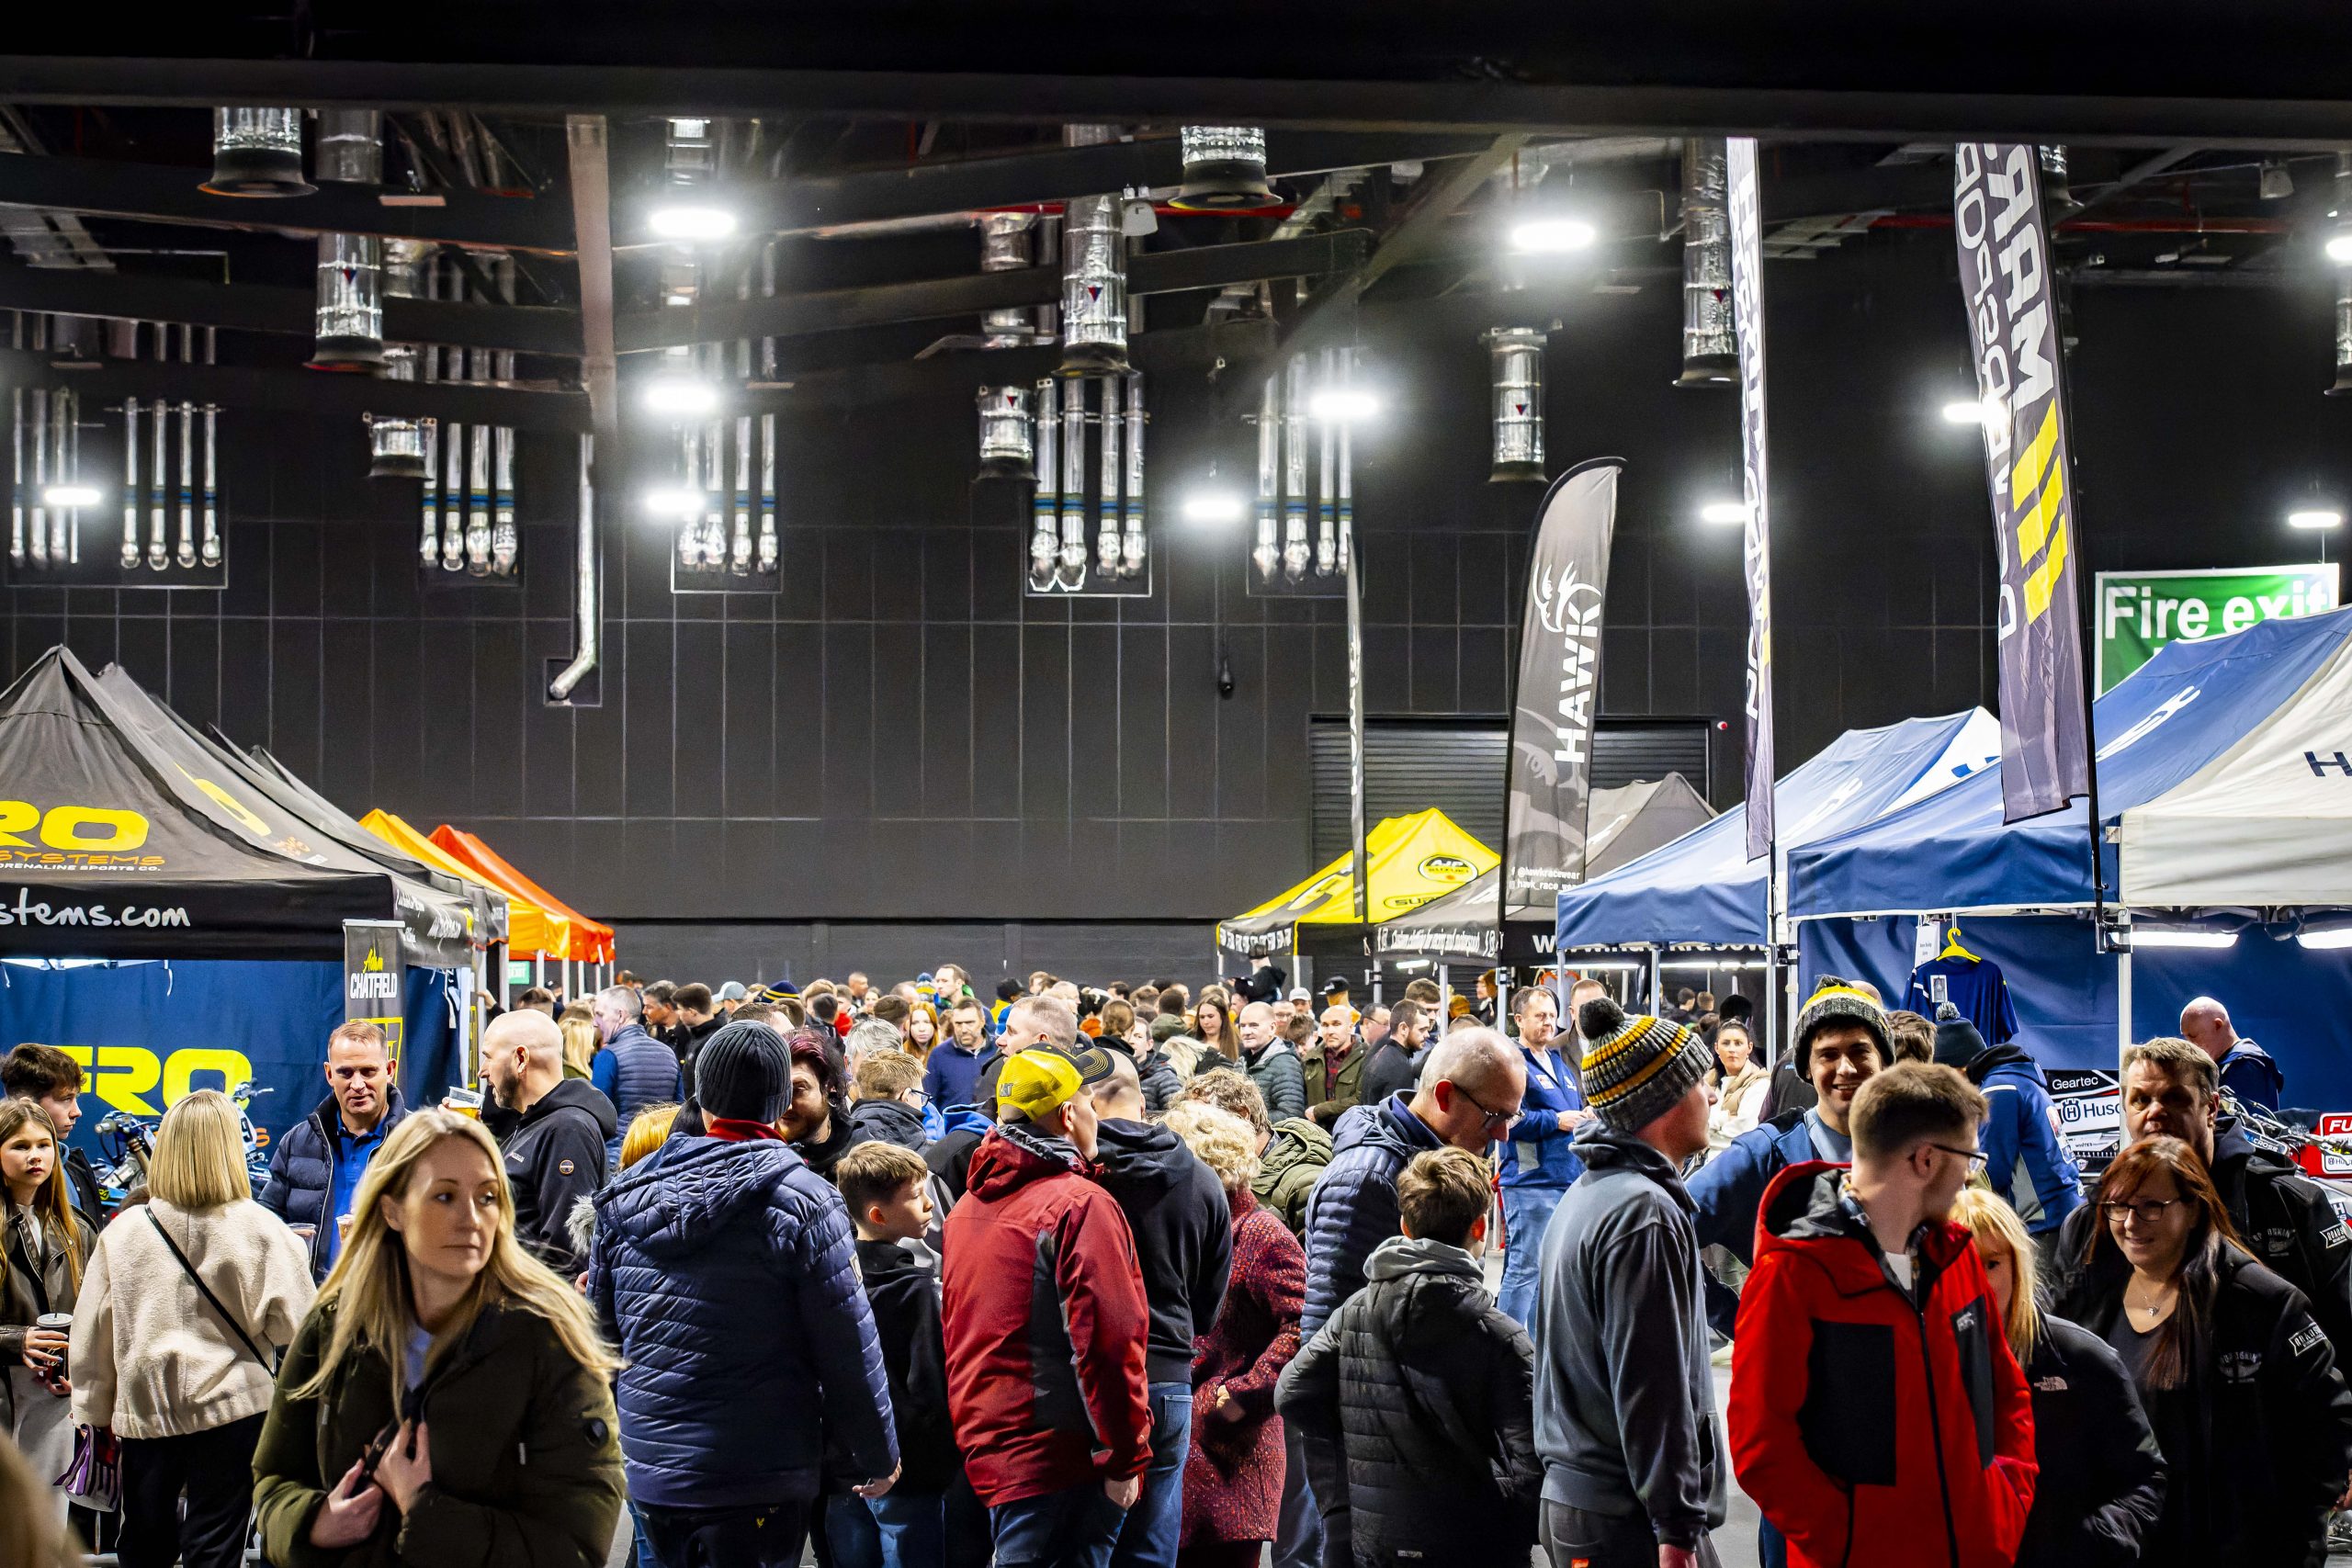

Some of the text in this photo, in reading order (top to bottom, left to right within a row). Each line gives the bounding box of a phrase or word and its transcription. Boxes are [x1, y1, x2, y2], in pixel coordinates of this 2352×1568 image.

[2105, 586, 2210, 640] Fire
[1555, 602, 1601, 763] HAWK
[350, 972, 398, 999] CHATFIELD
[2052, 1077, 2099, 1090] Geartec
